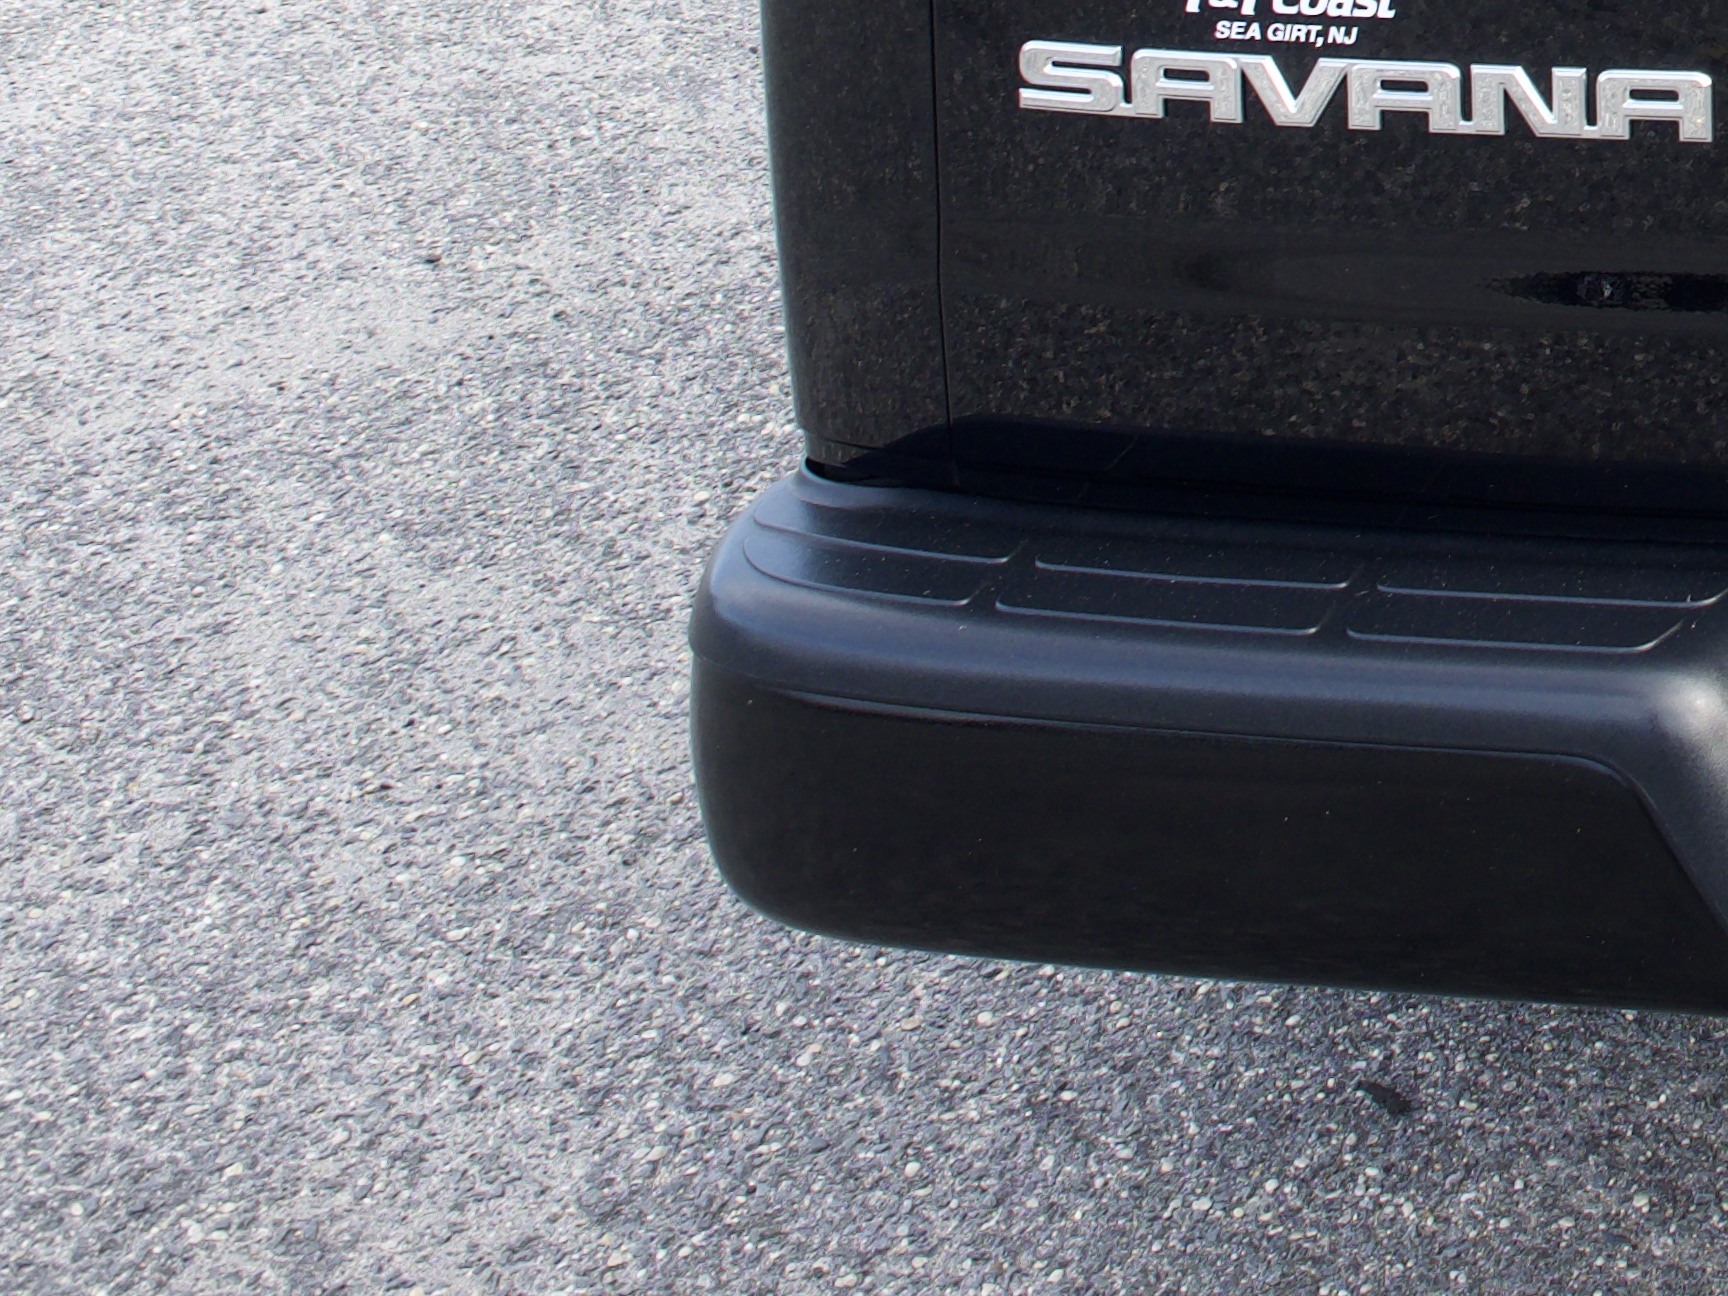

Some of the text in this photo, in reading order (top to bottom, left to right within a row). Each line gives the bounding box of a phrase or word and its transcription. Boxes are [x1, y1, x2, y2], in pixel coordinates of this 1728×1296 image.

[1214, 20, 1359, 48] SEA GIRT, NJ
[1018, 39, 1713, 143] SAVANA
